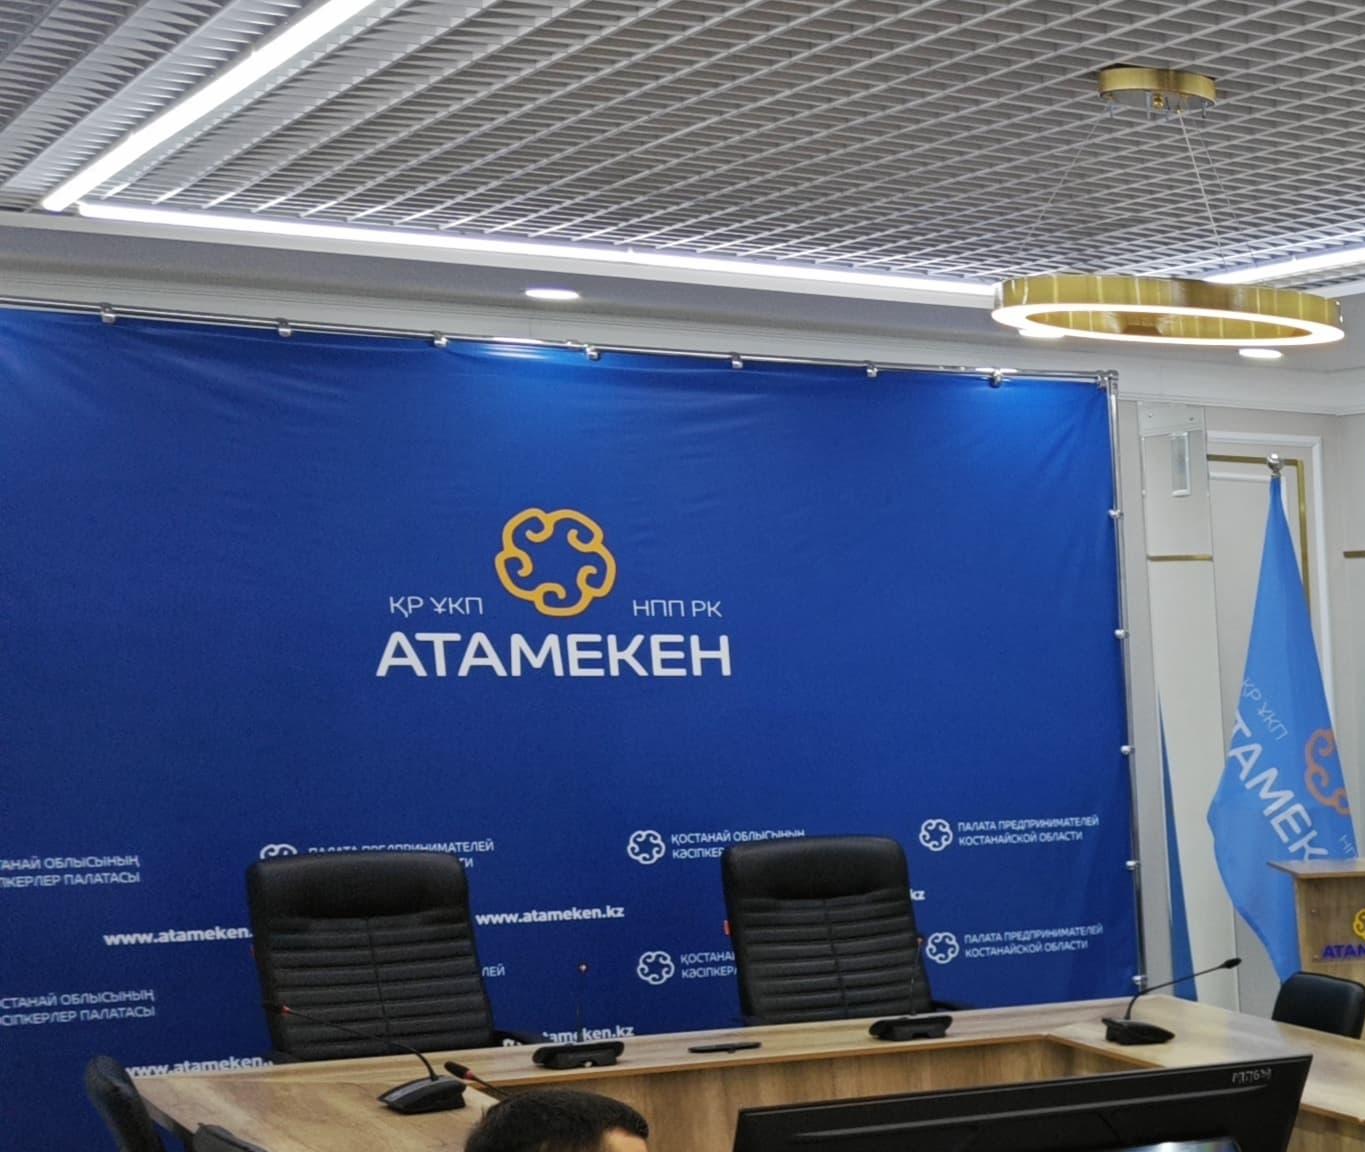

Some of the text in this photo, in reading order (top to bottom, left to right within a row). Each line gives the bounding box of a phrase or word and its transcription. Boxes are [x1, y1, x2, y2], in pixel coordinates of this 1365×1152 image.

[389, 596, 484, 618] ҚР ҰКП
[632, 599, 723, 617] НПП РК
[375, 630, 732, 677] АТАМЕКЕН
[958, 814, 1099, 832] ПАЛАТА ПРЕДПРИНИМАТЕЛЕЙ
[959, 831, 1083, 846] КОСТАНАЙСКОЙ ОБЛАСТИ
[64, 872, 141, 886] ПАЛАТАСЫ
[475, 904, 625, 926] www.atameken.kz
[964, 923, 1104, 945] ПАЛАТА ПРЕДПРИНИМАТЕЛЕЙ
[965, 939, 1089, 958] КОСТАНАЙСКОЙ ОБЛАСТИ
[80, 1006, 156, 1021] ПАЛАТАСЫ
